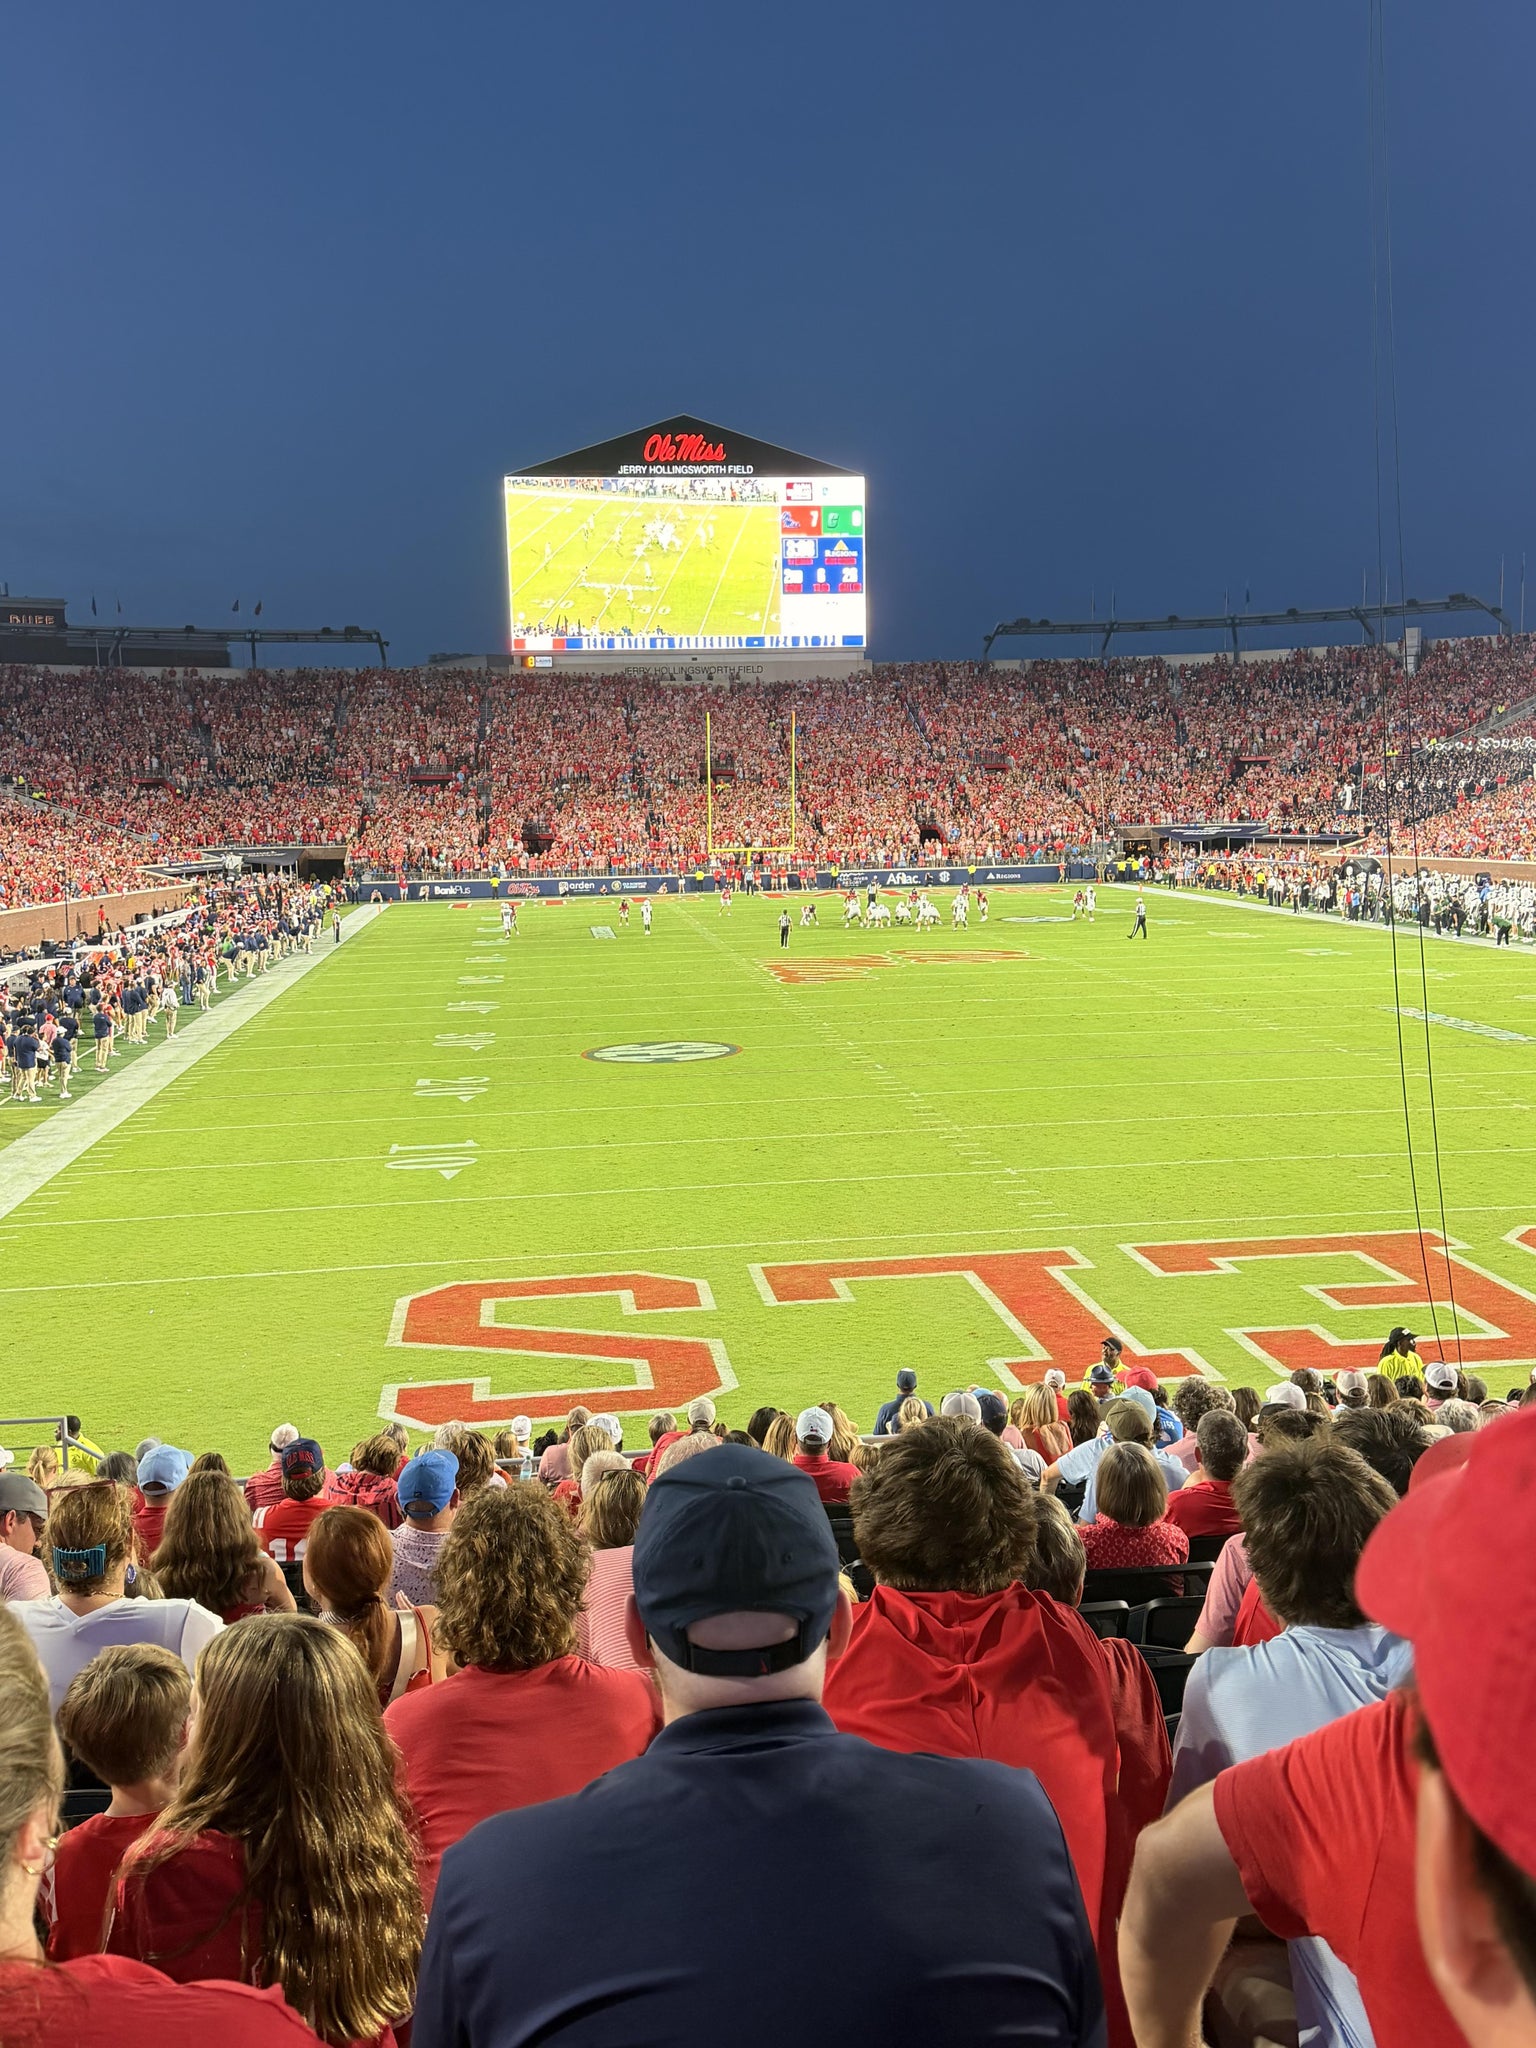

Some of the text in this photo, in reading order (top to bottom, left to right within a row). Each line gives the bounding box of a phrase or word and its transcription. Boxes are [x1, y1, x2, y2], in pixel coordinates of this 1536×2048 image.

[643, 433, 727, 462] Ole Miss
[618, 465, 754, 474] JERRY HOLLINGSWORTH FIELD
[810, 511, 819, 528] 7
[624, 665, 764, 675] JERRY HOLLINGSWORTH FIELD
[434, 885, 471, 895] BankPlus
[412, 1076, 490, 1097] 20
[384, 1139, 480, 1170] 10
